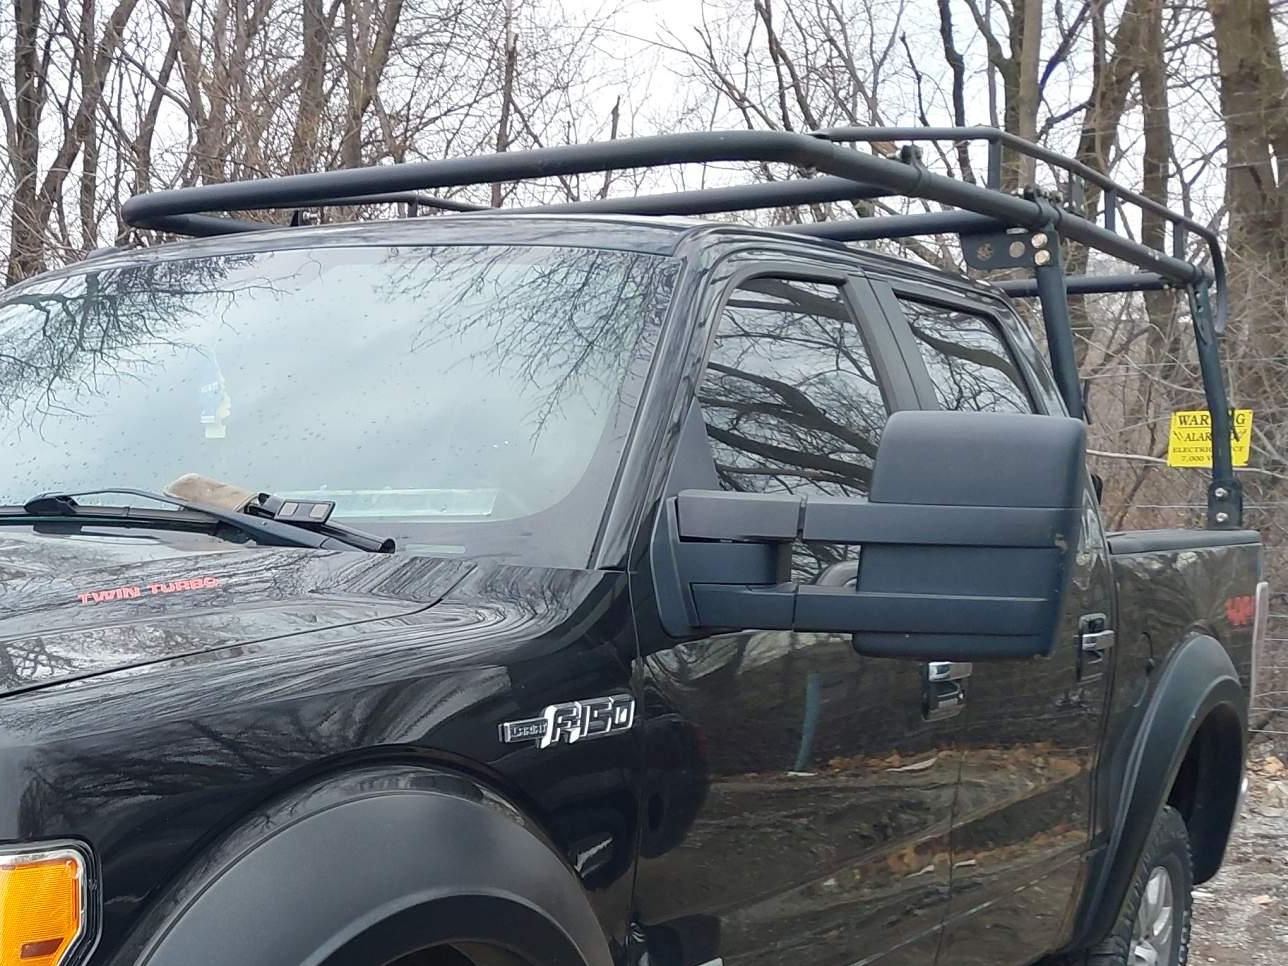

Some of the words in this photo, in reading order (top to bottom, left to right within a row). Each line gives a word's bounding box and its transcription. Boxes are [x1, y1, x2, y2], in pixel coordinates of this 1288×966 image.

[1178, 413, 1246, 427] WARG
[78, 585, 141, 605] TWIN
[149, 576, 220, 594] TURBO
